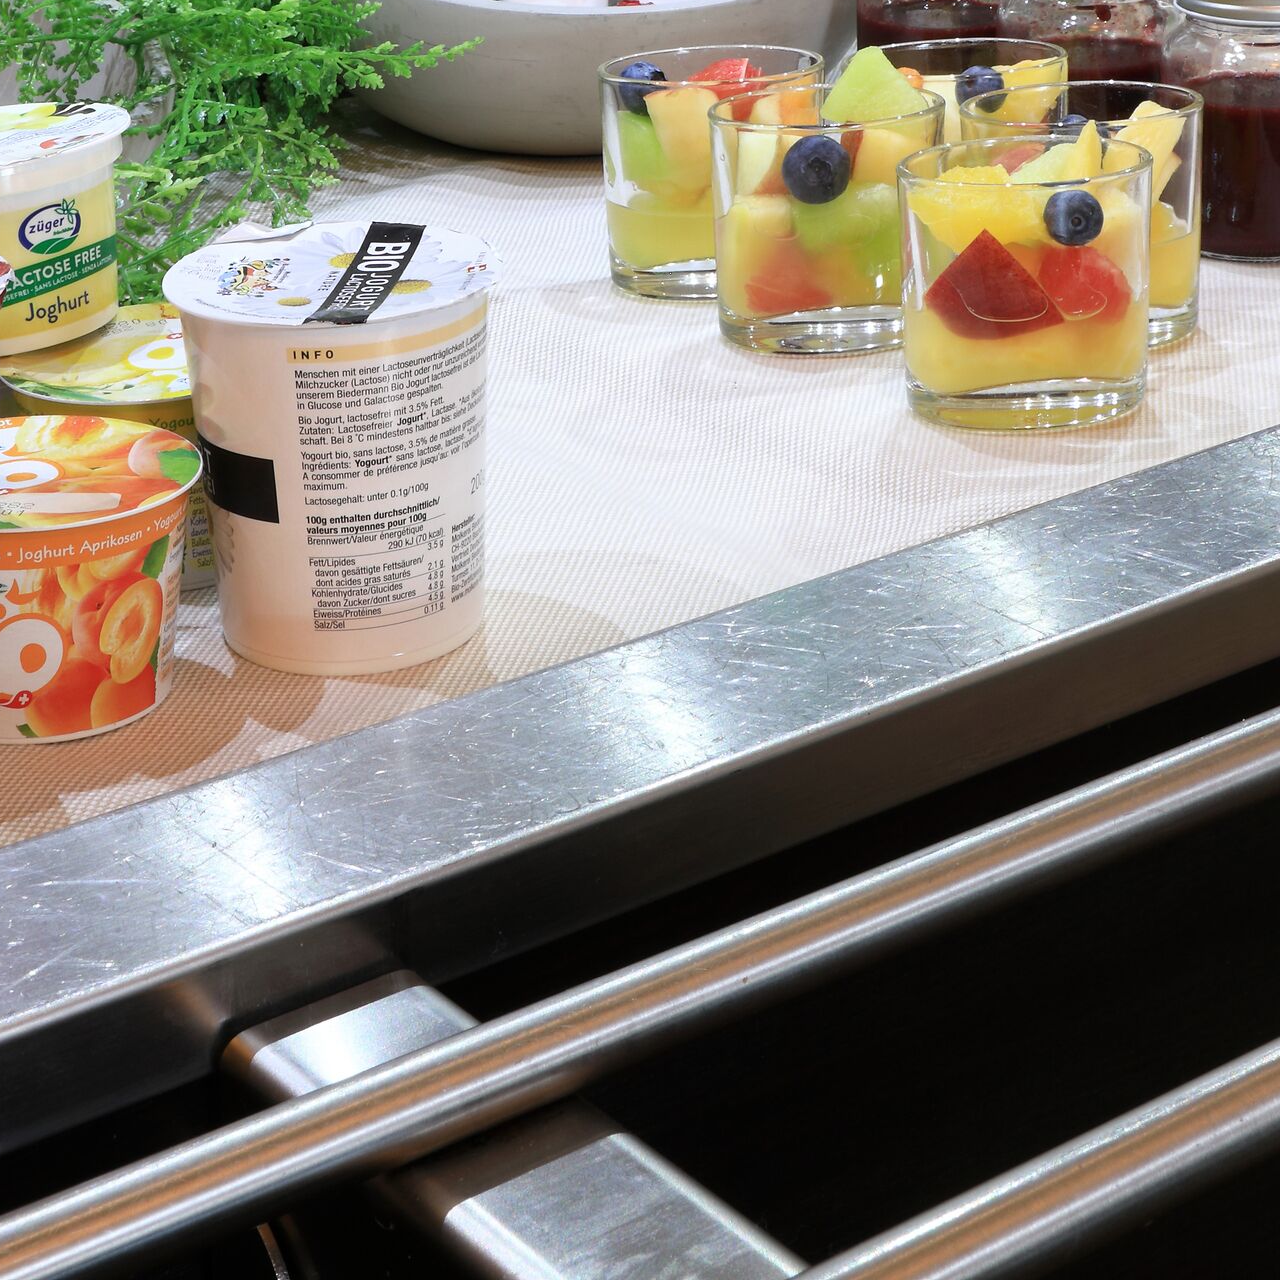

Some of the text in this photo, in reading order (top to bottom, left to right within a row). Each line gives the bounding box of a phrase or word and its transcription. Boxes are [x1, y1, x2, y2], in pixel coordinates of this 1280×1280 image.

[29, 216, 65, 235] züger
[74, 245, 102, 268] FREE
[34, 280, 52, 293] SANS
[53, 271, 78, 286] LACTOSE
[348, 241, 412, 312] BIO JOGURT
[25, 290, 90, 324] Joghurt
[293, 350, 334, 360] INFO
[294, 370, 340, 379] Menschen
[342, 368, 357, 377] mit
[359, 366, 381, 375] einer
[296, 379, 348, 389] Milchzucker
[350, 375, 390, 388] (Lactose)
[296, 385, 389, 400] unserem Biedermann
[307, 392, 405, 410] Glucose Galactose
[314, 409, 391, 426] Jogurt, lactosefrei
[299, 420, 393, 435] Zutaten: Lactosefreier
[300, 425, 414, 446] schaft. mindestens
[300, 451, 333, 462] Yogourt
[301, 460, 352, 472] Ingrédients:
[311, 470, 360, 481] consommer
[304, 481, 348, 491] maximum.
[304, 495, 365, 507] Lactosegehalt:
[306, 514, 371, 527] 100g enthalten
[306, 523, 385, 536] valeurs moyennes
[17, 545, 74, 563] Joghurt
[79, 529, 143, 554] Aprikosen
[309, 558, 356, 568] Fett/Lipides
[313, 607, 382, 619] Eiweiss/Protéines
[314, 620, 346, 629] Salz/Sel
